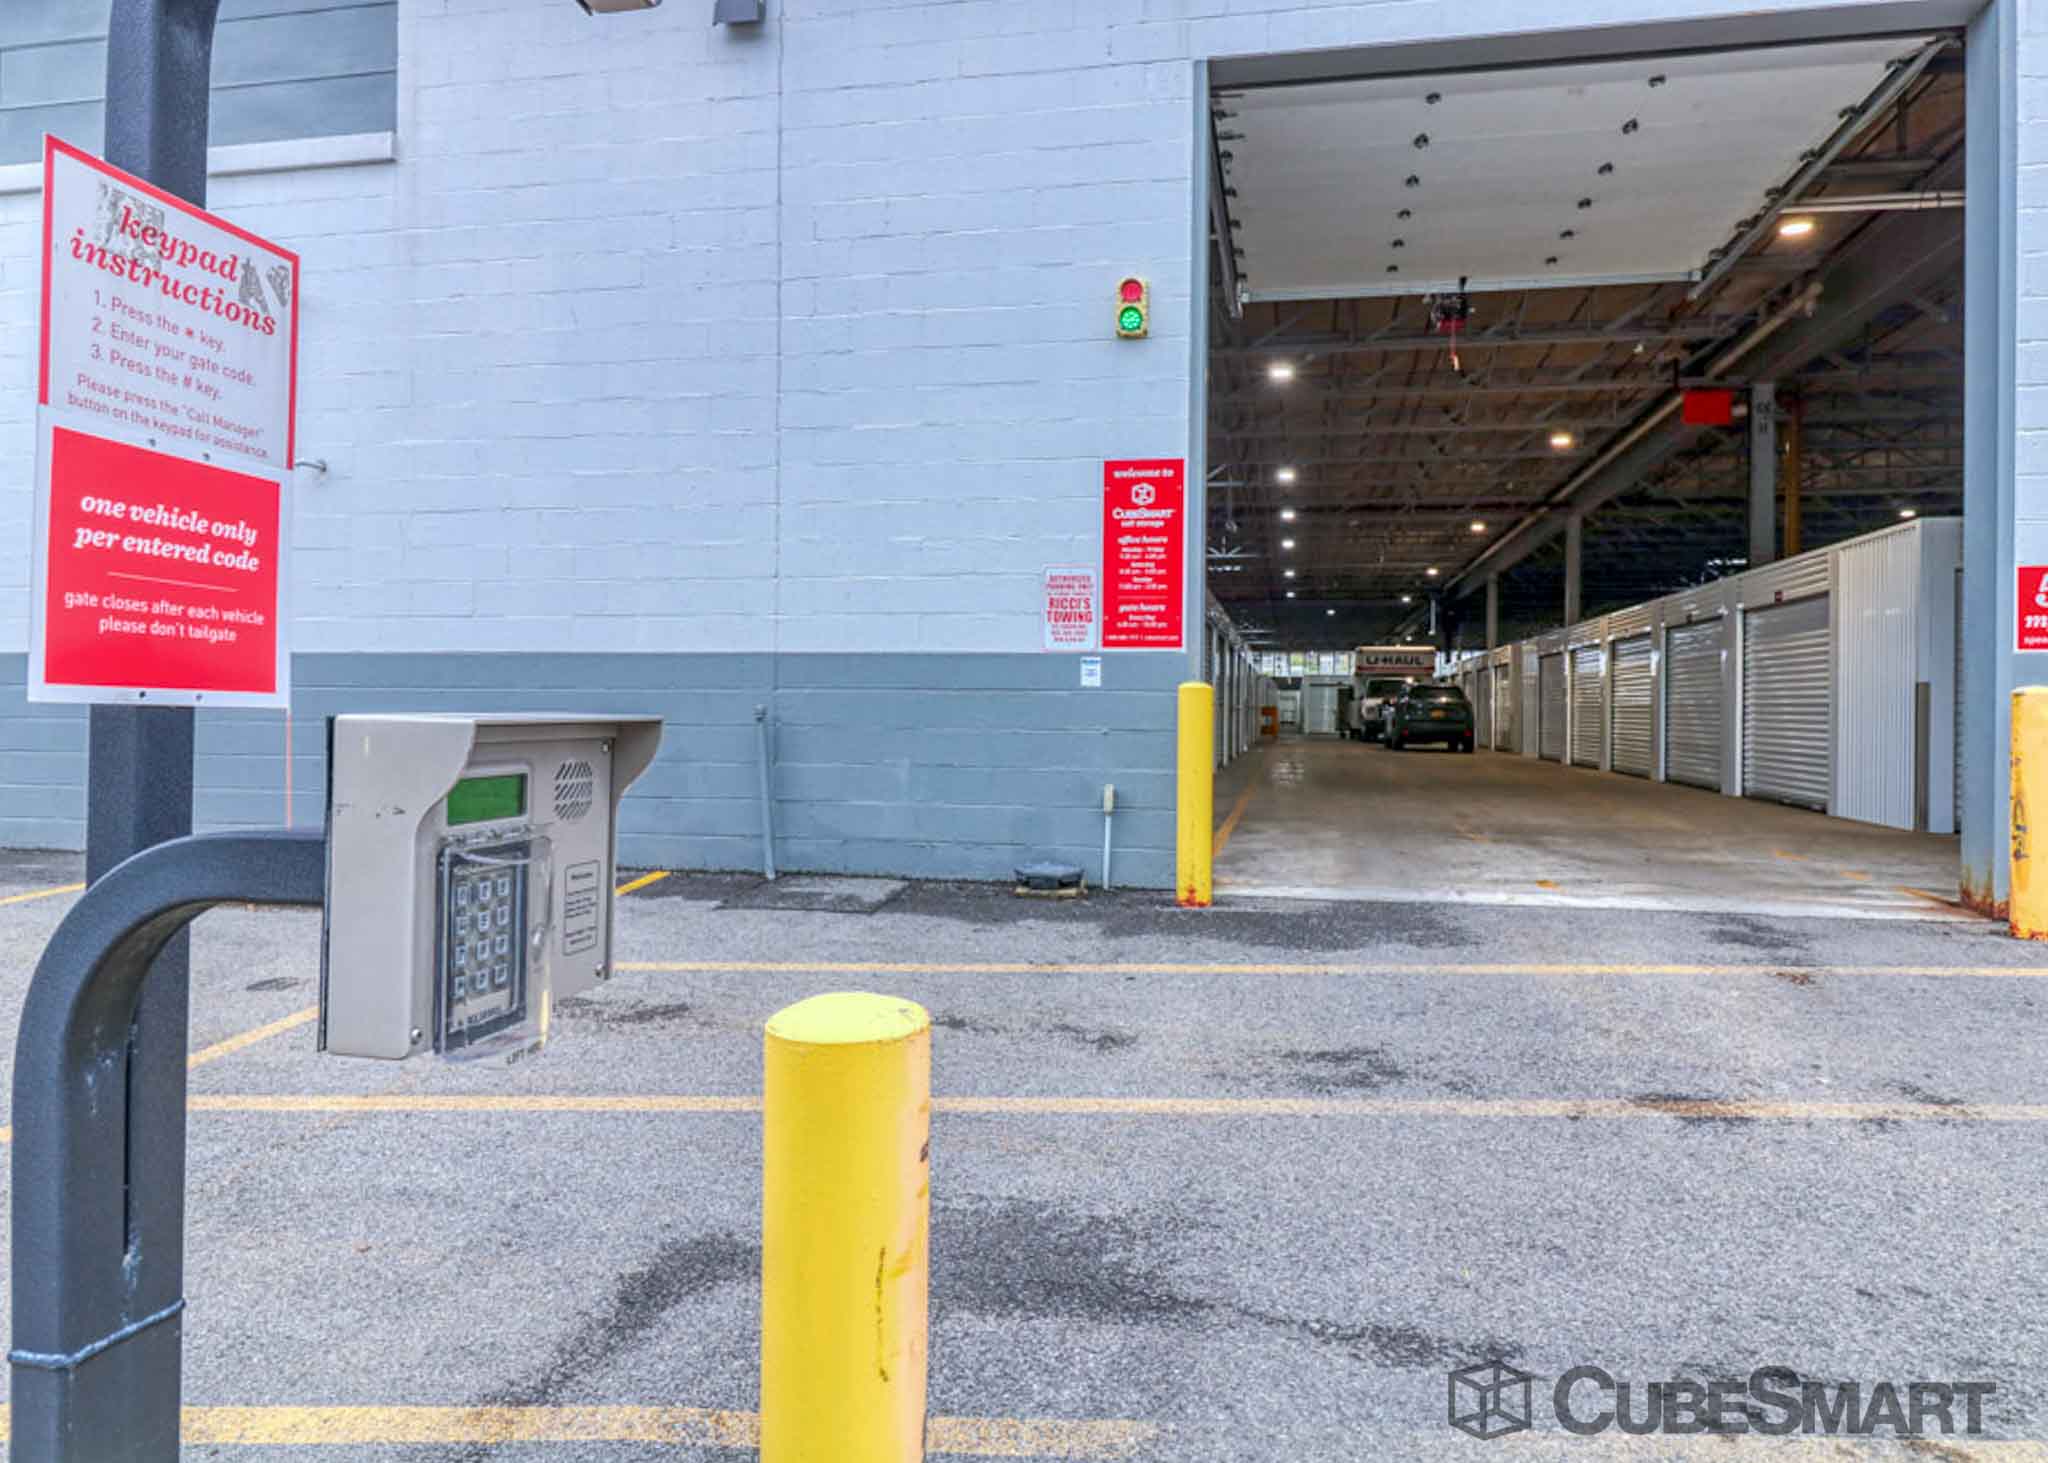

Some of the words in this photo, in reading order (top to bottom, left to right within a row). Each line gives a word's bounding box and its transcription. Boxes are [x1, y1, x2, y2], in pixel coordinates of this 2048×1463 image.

[119, 206, 239, 282] keypad
[70, 228, 277, 336] instructions
[91, 316, 106, 337] 2.
[111, 321, 151, 350] Enter
[154, 341, 186, 359] your
[190, 354, 220, 374] gate
[94, 289, 107, 309] 1.
[111, 296, 153, 326] Press
[156, 314, 180, 335] the
[199, 329, 226, 353] key.
[90, 343, 105, 362] 3.
[110, 349, 151, 377] Press
[155, 366, 179, 386] the
[66, 391, 110, 415] button
[111, 406, 128, 421] on
[130, 409, 150, 428] the
[152, 417, 194, 439] keypad
[194, 428, 212, 443] for
[77, 373, 121, 399] Please
[124, 389, 158, 409] press
[159, 400, 179, 417] the
[80, 496, 127, 518] one
[129, 503, 210, 534] vehicle
[211, 520, 258, 547] only
[73, 526, 120, 549] per
[122, 534, 211, 565] entered
[212, 549, 260, 572] code
[64, 592, 98, 609] gate
[102, 594, 149, 614] closes
[151, 600, 185, 618] after
[187, 604, 220, 621] each
[222, 608, 265, 625] vehicle
[99, 615, 147, 635] please
[150, 620, 185, 638] don't
[188, 625, 237, 643] tailgate
[1047, 610, 1093, 623] TOWING
